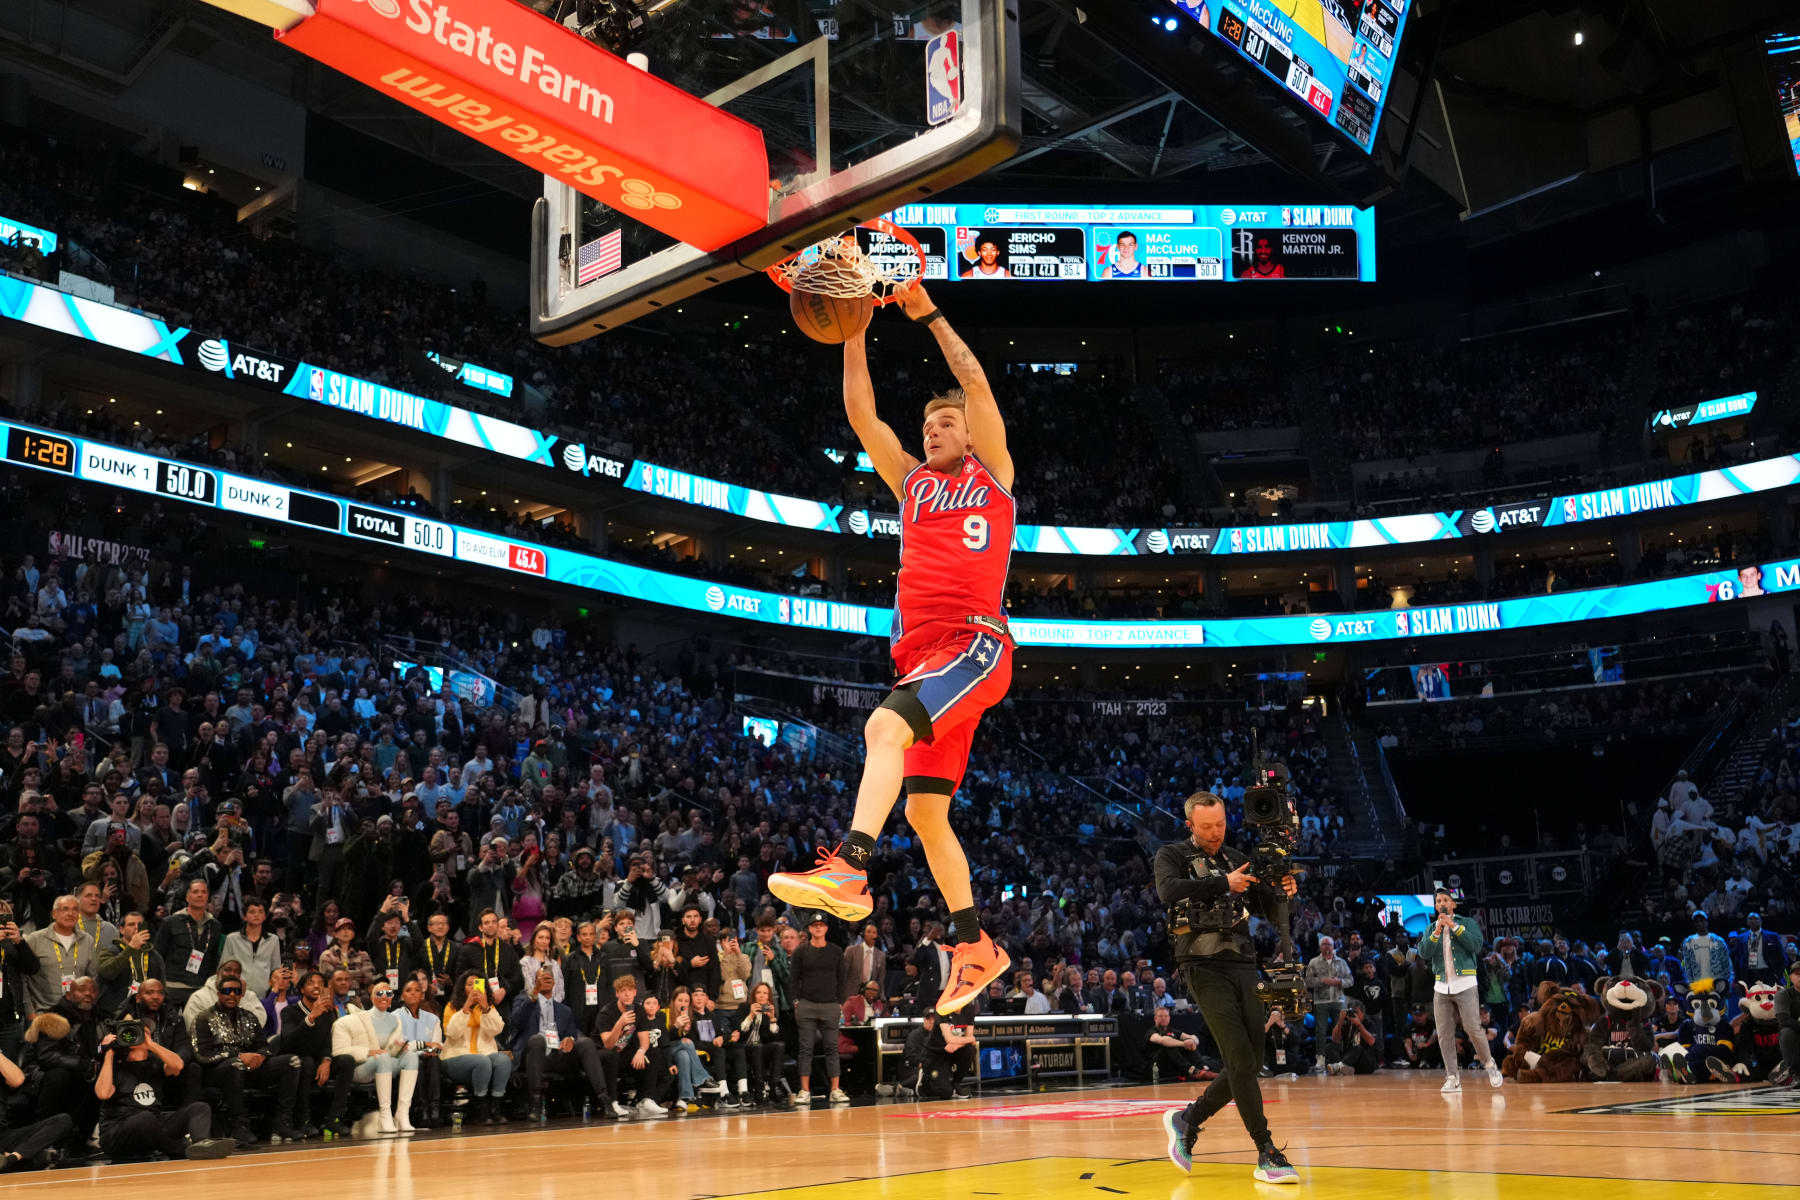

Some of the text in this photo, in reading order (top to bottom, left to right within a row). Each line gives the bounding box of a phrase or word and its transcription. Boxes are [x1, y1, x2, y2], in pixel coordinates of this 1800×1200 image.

[1223, 16, 1242, 40] 1:28
[1246, 31, 1264, 60] 50.0
[1291, 67, 1309, 94] 50.0
[932, 101, 948, 119] NBA
[895, 206, 957, 225] SLAM DUNK
[1015, 211, 1043, 220] FIRST
[1047, 211, 1079, 220] ROUND
[1088, 212, 1109, 220] TOP
[1111, 212, 1116, 220] 2
[1118, 212, 1163, 220] ADVANCE
[1239, 212, 1267, 222] AT&T
[1293, 208, 1353, 226] SLAM DUNK
[868, 231, 897, 243] TREY
[960, 230, 966, 238] 2
[1008, 233, 1055, 243] JERICHO
[1146, 233, 1171, 243] MAC
[1282, 234, 1326, 244] KENYON
[1008, 244, 1037, 254] SIMS
[1146, 245, 1198, 254] McCLUNG
[1282, 245, 1344, 255] MARTIN JR.
[1013, 264, 1031, 277] 47.6
[1039, 264, 1055, 277] 47.8
[1064, 264, 1080, 276] 95.4
[1151, 264, 1168, 277] 50.0
[1201, 265, 1217, 276] 50.0
[233, 353, 285, 383] AT&T
[328, 371, 426, 430] SLAM DUNK
[1708, 398, 1748, 417] SLAM DUNK
[1673, 411, 1691, 422] AT&T
[24, 436, 68, 467] 1:28
[88, 454, 150, 481] DUNK 1
[588, 455, 625, 479] AT&T
[167, 464, 206, 499] 50.0
[656, 468, 730, 511] SLAM DUNK
[227, 485, 284, 510] DUNK 2
[911, 476, 991, 523] Phila
[1582, 480, 1676, 520] SLAM DUNK
[354, 513, 399, 538] TOTAL
[1499, 508, 1541, 527] AT&T
[413, 522, 444, 550] 50.0
[962, 514, 991, 552] 9
[1172, 534, 1210, 549] AT&T
[1246, 524, 1331, 552] SLAM DUNK
[515, 549, 538, 570] 45.4
[728, 598, 762, 614] AT&T
[793, 600, 868, 633] SLAM DUNK
[1412, 603, 1500, 635] SLAM DUNK
[1030, 627, 1075, 640] ROUND
[1088, 628, 1113, 641] TOP
[1116, 628, 1125, 641] 2
[1128, 628, 1191, 641] ADVANCE
[1335, 619, 1375, 637] AT&T
[1531, 904, 1553, 924] 2023
[1033, 1052, 1075, 1070] SATURDAY
